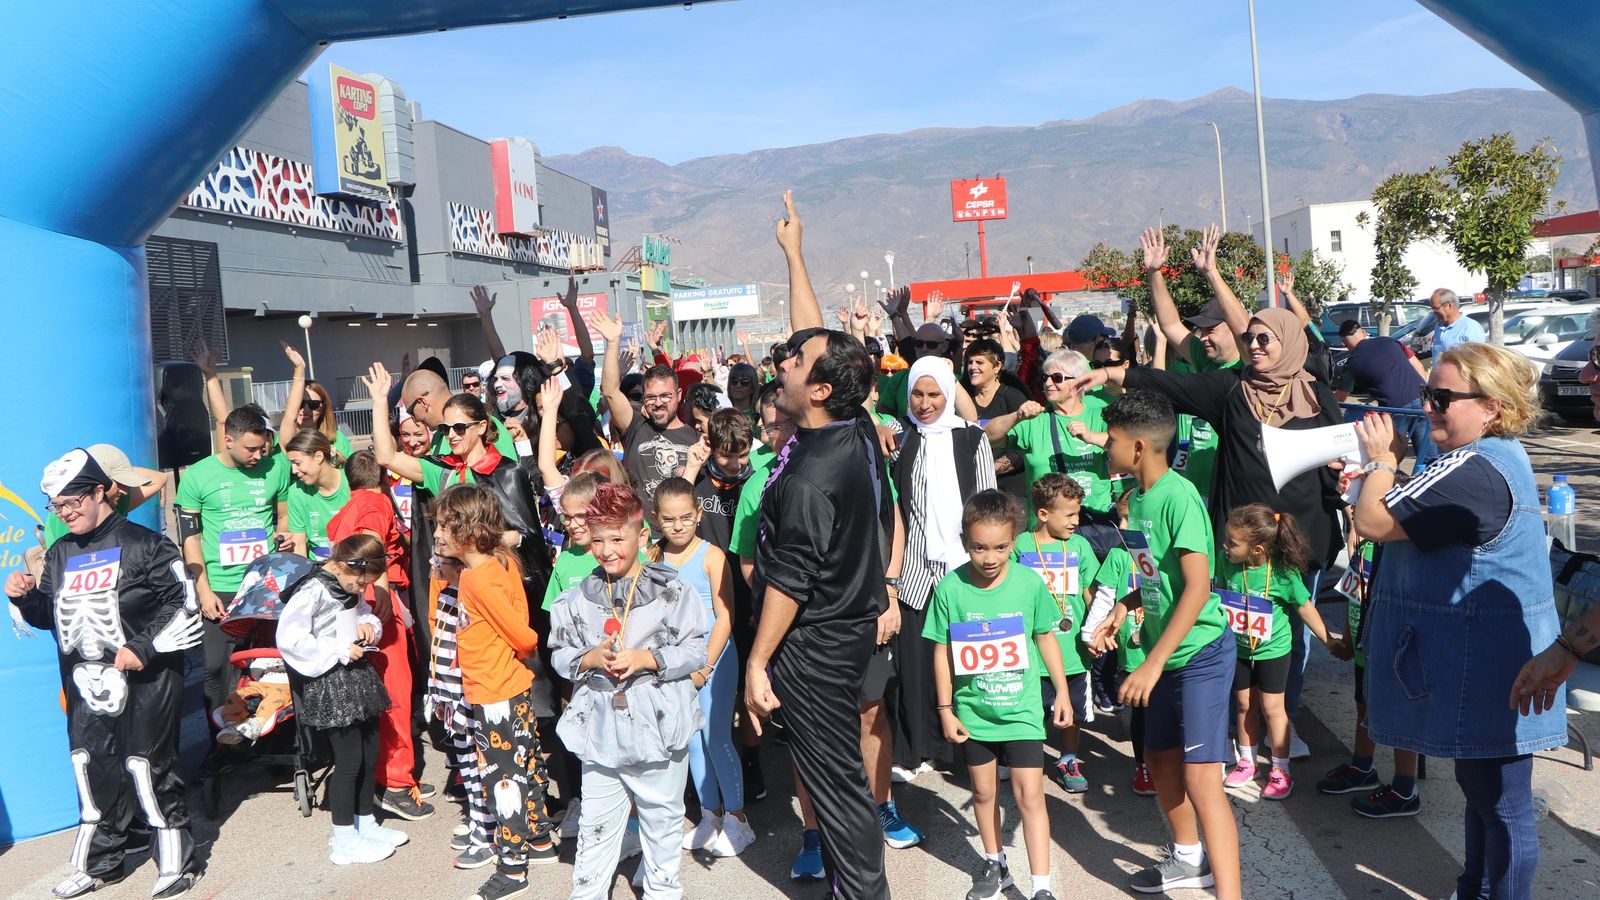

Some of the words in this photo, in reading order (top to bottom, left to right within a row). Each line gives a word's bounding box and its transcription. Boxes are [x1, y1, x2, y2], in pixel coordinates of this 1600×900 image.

[339, 83, 373, 105] KARTING
[965, 199, 995, 209] CEPSA
[673, 291, 706, 299] PARKING
[707, 287, 743, 297] GRATUITO
[226, 544, 264, 563] 178
[68, 567, 113, 593] 402
[960, 641, 1020, 671] 093
[977, 680, 1023, 695] HALLOWEEN
